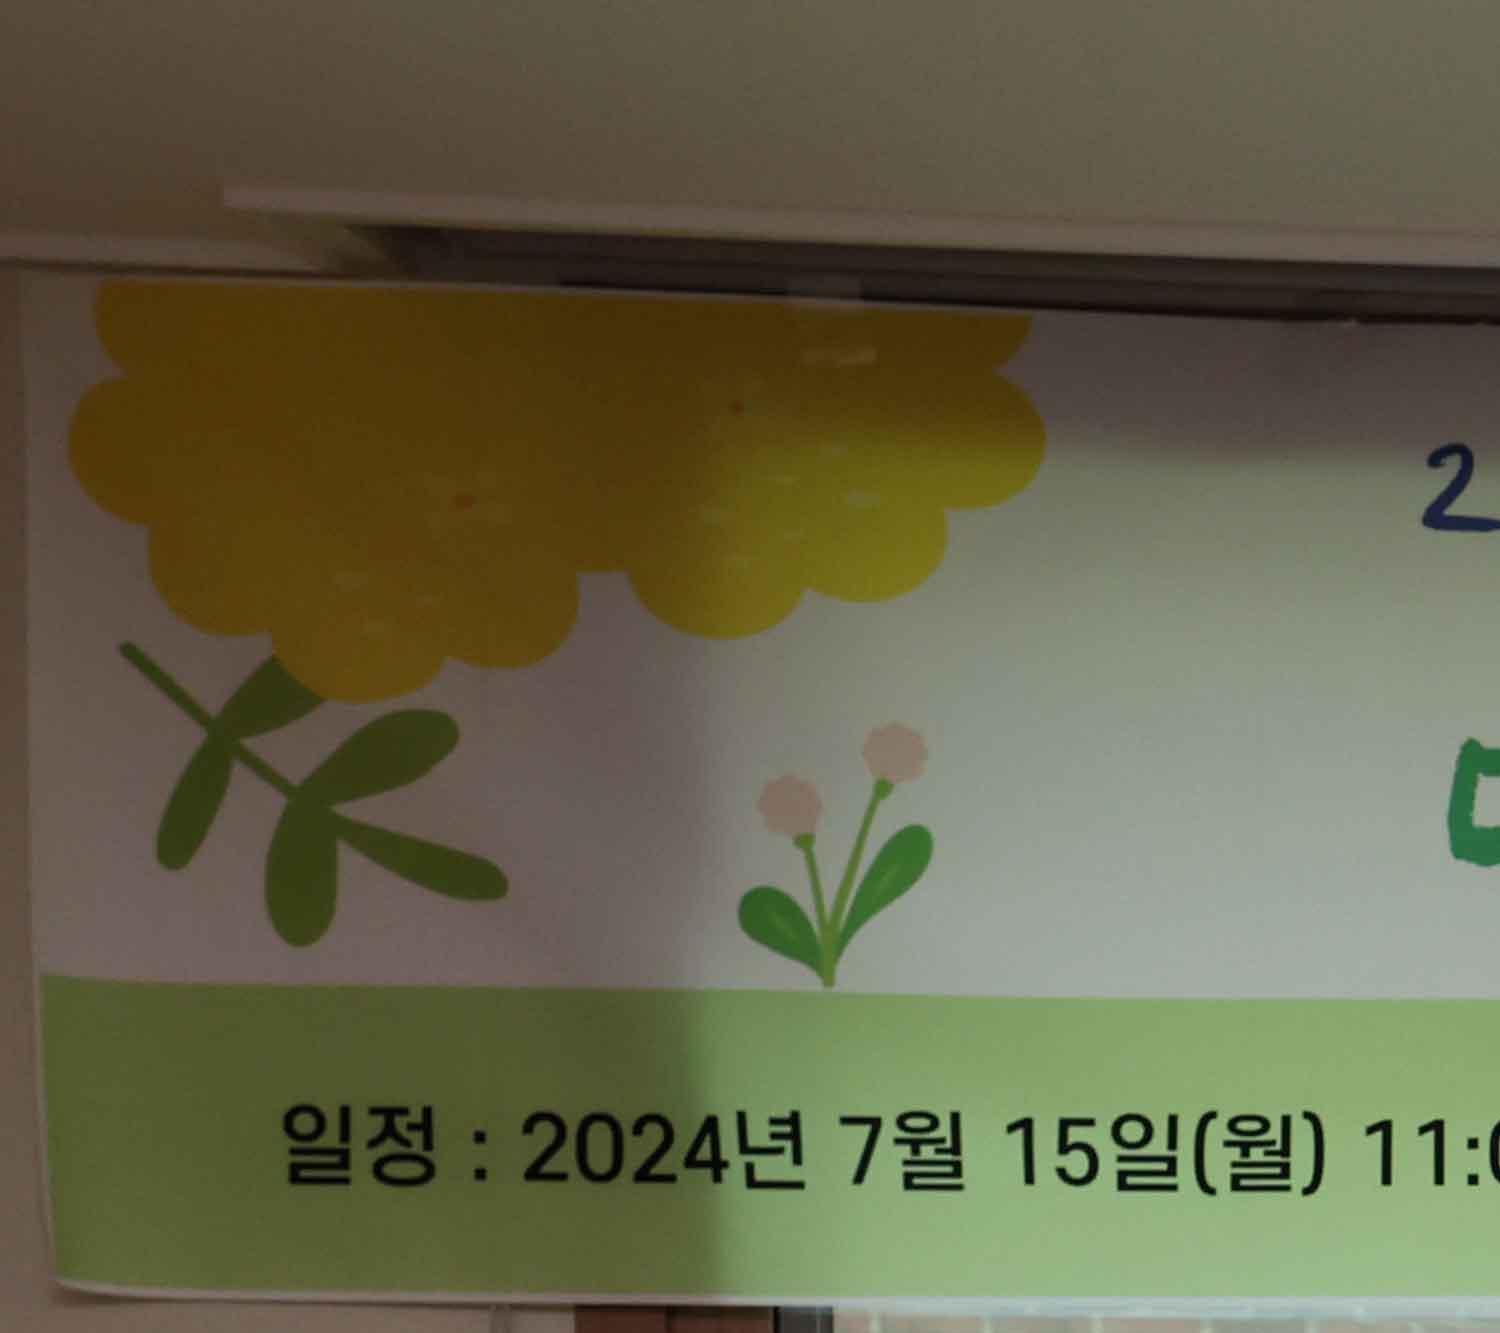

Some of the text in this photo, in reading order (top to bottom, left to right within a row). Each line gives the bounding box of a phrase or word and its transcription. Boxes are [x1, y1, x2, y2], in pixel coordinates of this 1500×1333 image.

[281, 1103, 437, 1188] 일정
[521, 1110, 807, 1192] 2024년
[838, 1110, 966, 1192] 7월
[1005, 1109, 1327, 1197] 15일(월)
